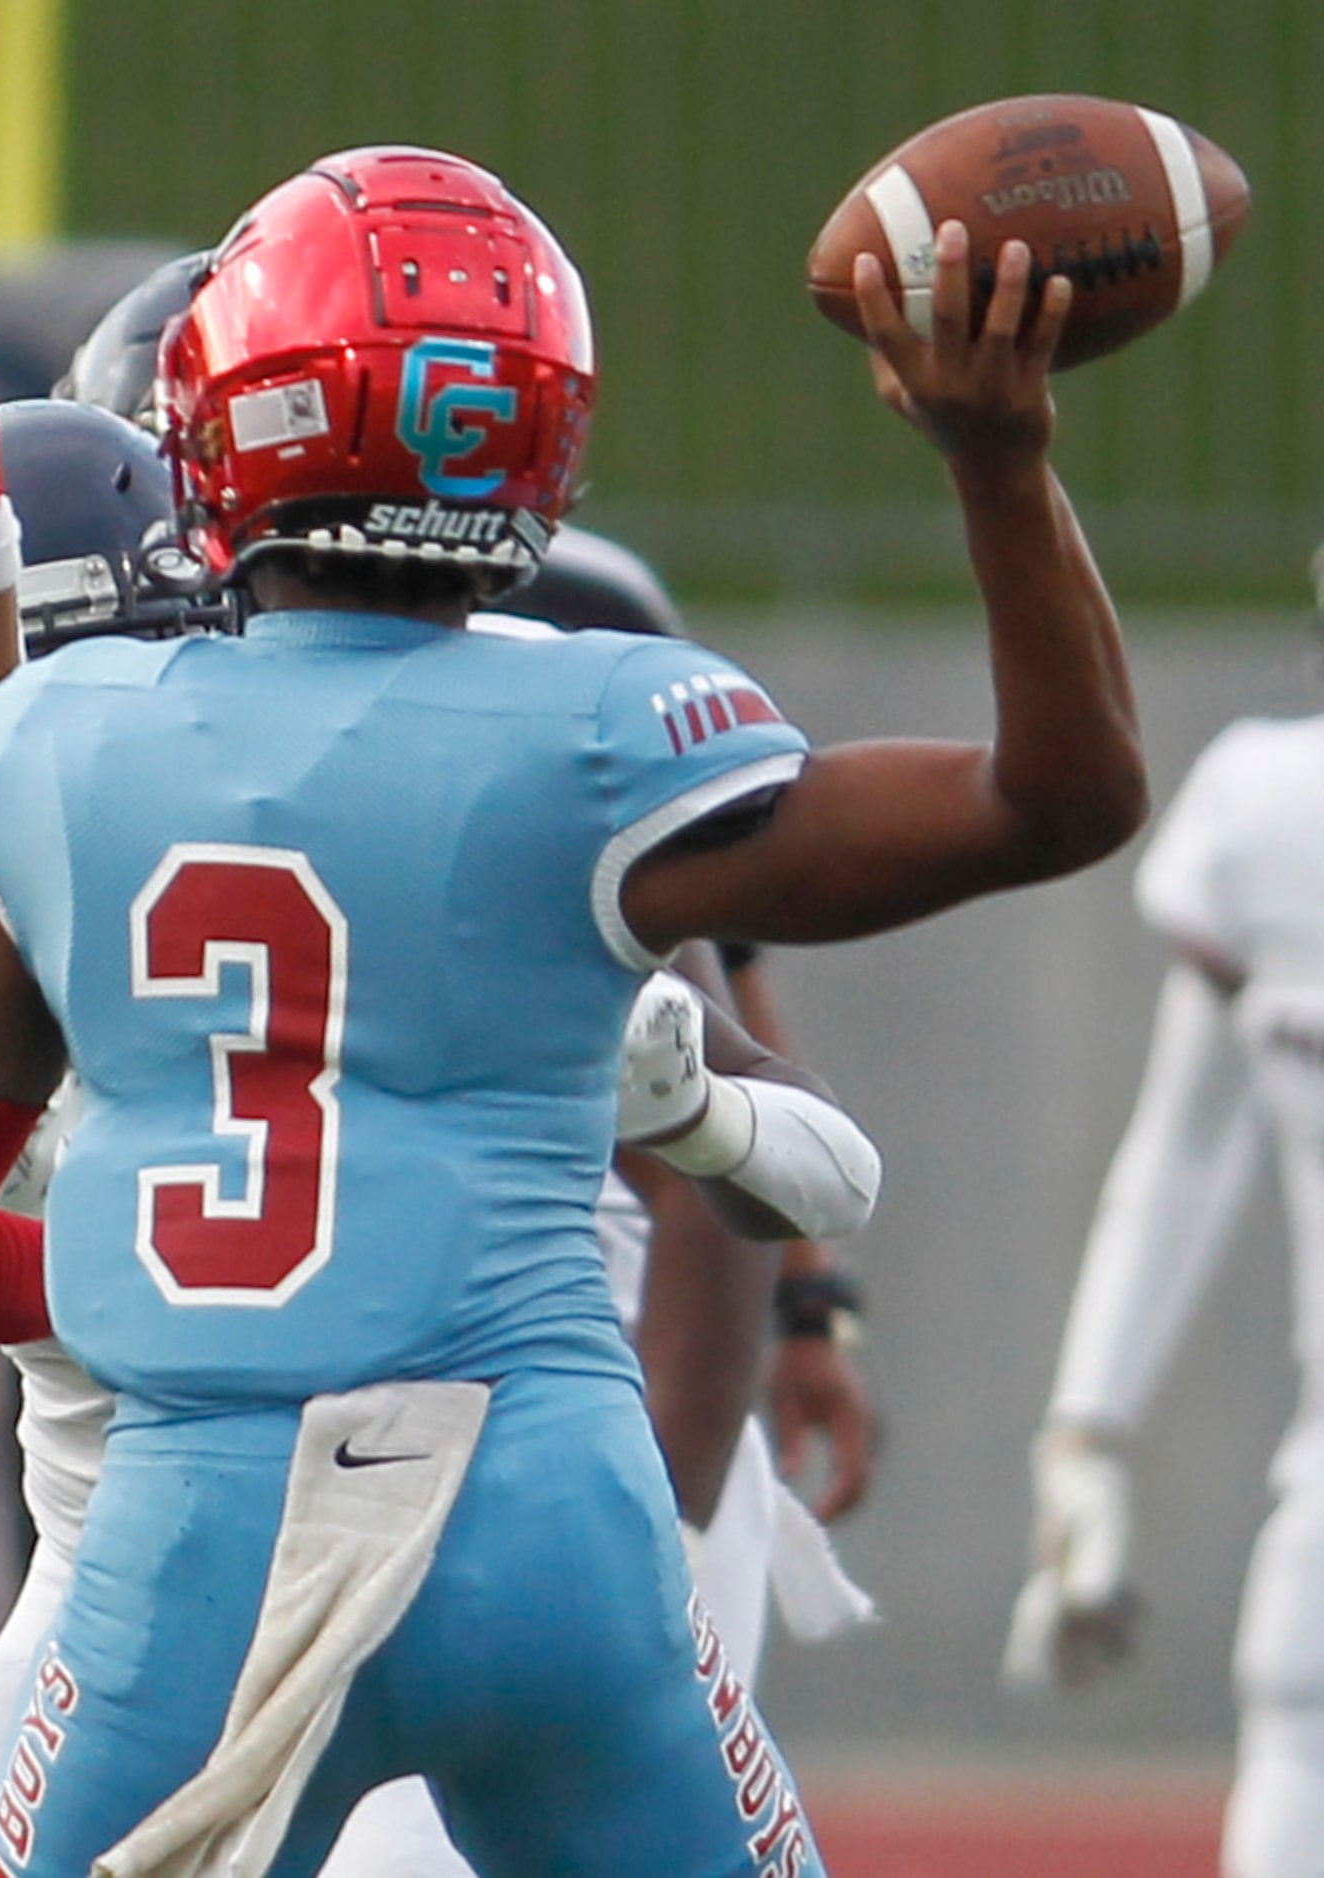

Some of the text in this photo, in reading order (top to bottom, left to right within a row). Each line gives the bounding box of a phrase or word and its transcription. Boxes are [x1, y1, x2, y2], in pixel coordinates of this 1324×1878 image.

[982, 168, 1132, 216] Wilson
[364, 499, 507, 542] schutt
[129, 842, 349, 1307] 3
